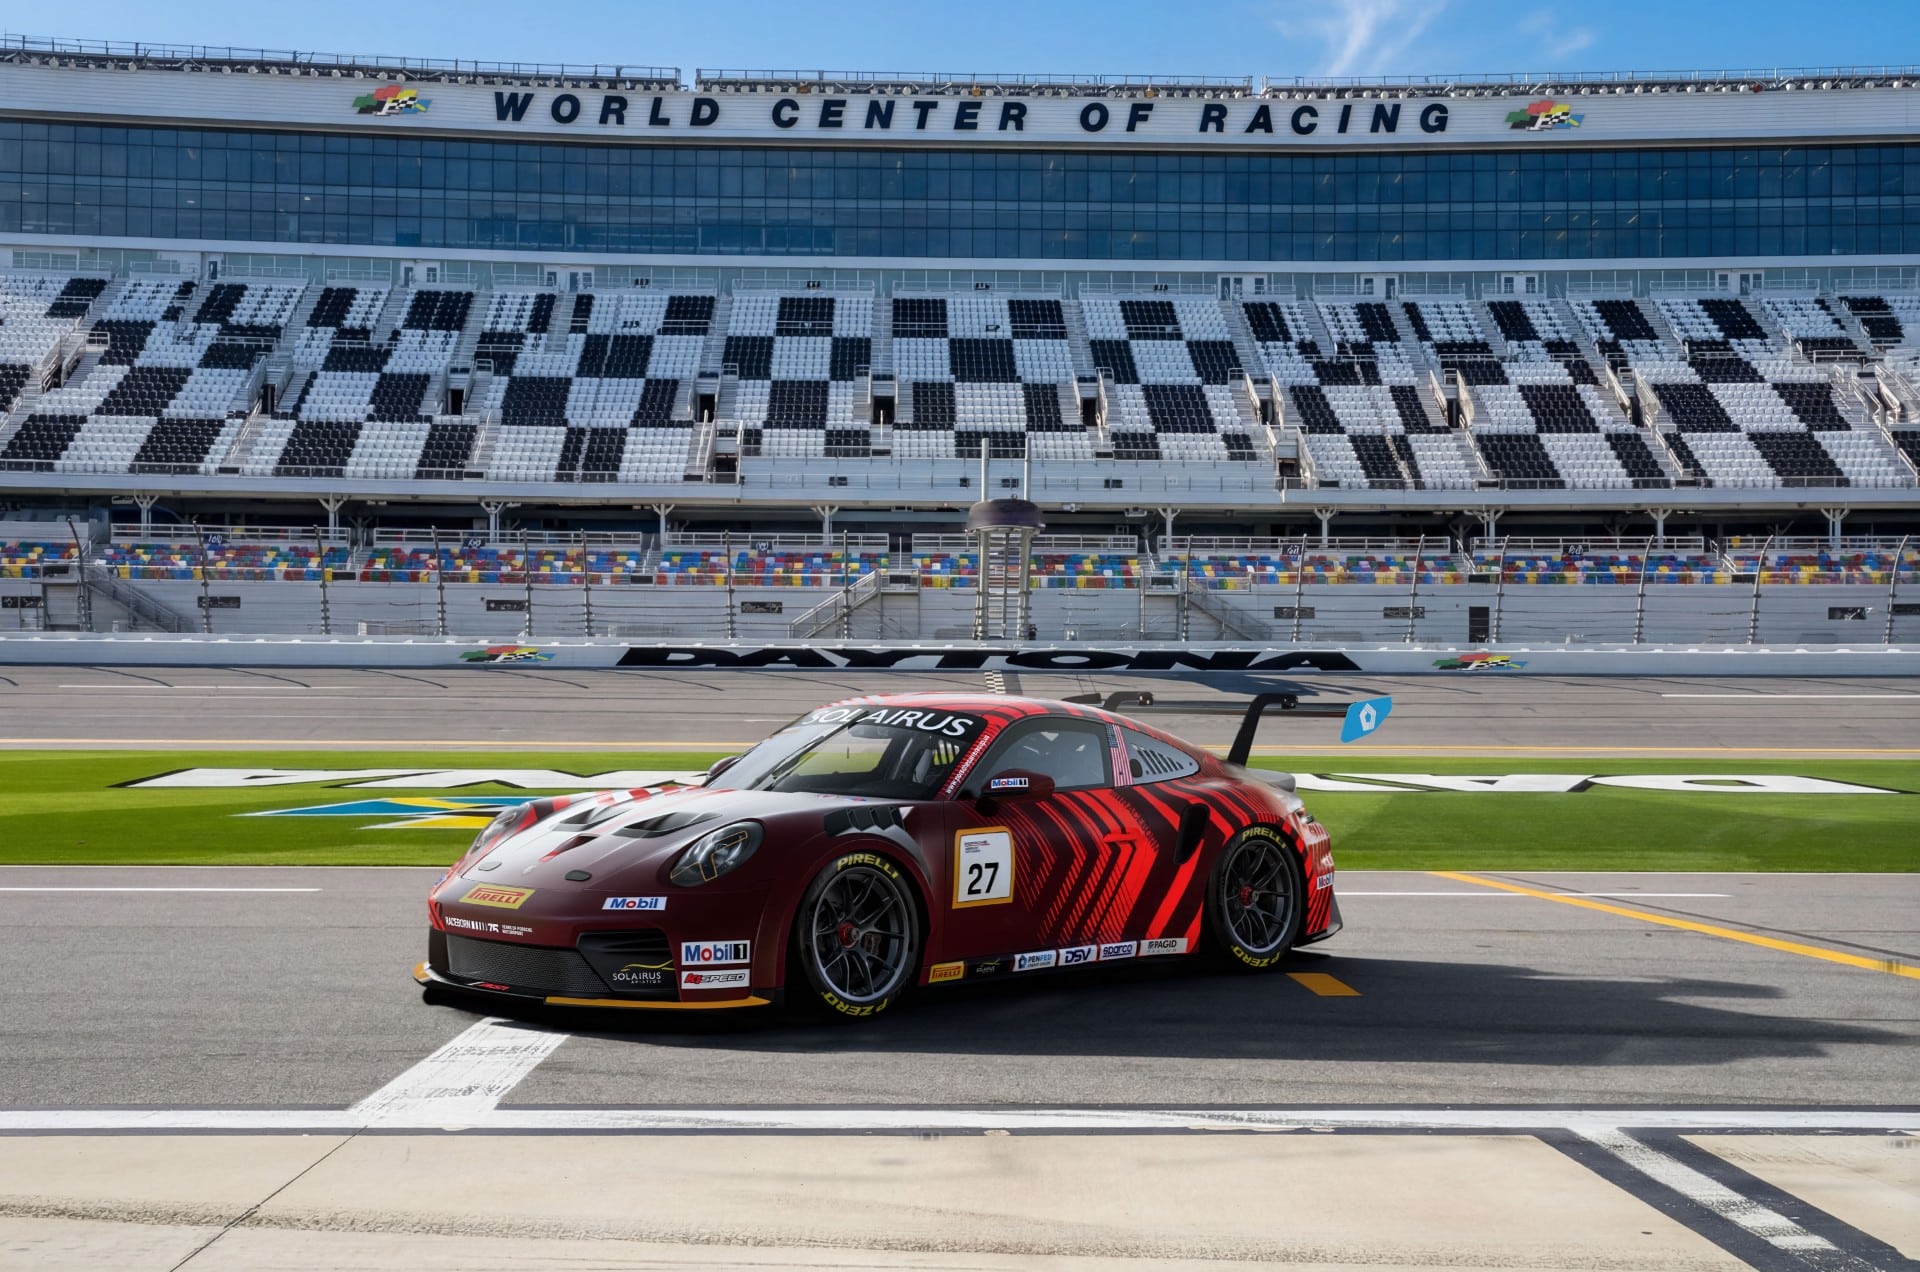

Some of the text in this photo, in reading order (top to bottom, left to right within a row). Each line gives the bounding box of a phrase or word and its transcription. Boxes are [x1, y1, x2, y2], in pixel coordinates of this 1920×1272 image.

[493, 91, 1450, 136] WORLD CENTER OF RACING
[616, 646, 1363, 671] DAYTONA
[802, 707, 975, 737] SOLAIRUS
[1241, 826, 1287, 849] PIRELLI
[836, 853, 899, 879] PIRELLI
[967, 862, 1000, 896] 27
[467, 887, 526, 904] PIRELLI
[610, 898, 659, 909] Mobil
[1064, 948, 1092, 964] DSV
[1232, 946, 1269, 968] ZERO
[612, 971, 661, 981] SOLAIRUS
[931, 965, 961, 979] PIRELLI
[823, 991, 873, 1017] ZERO
